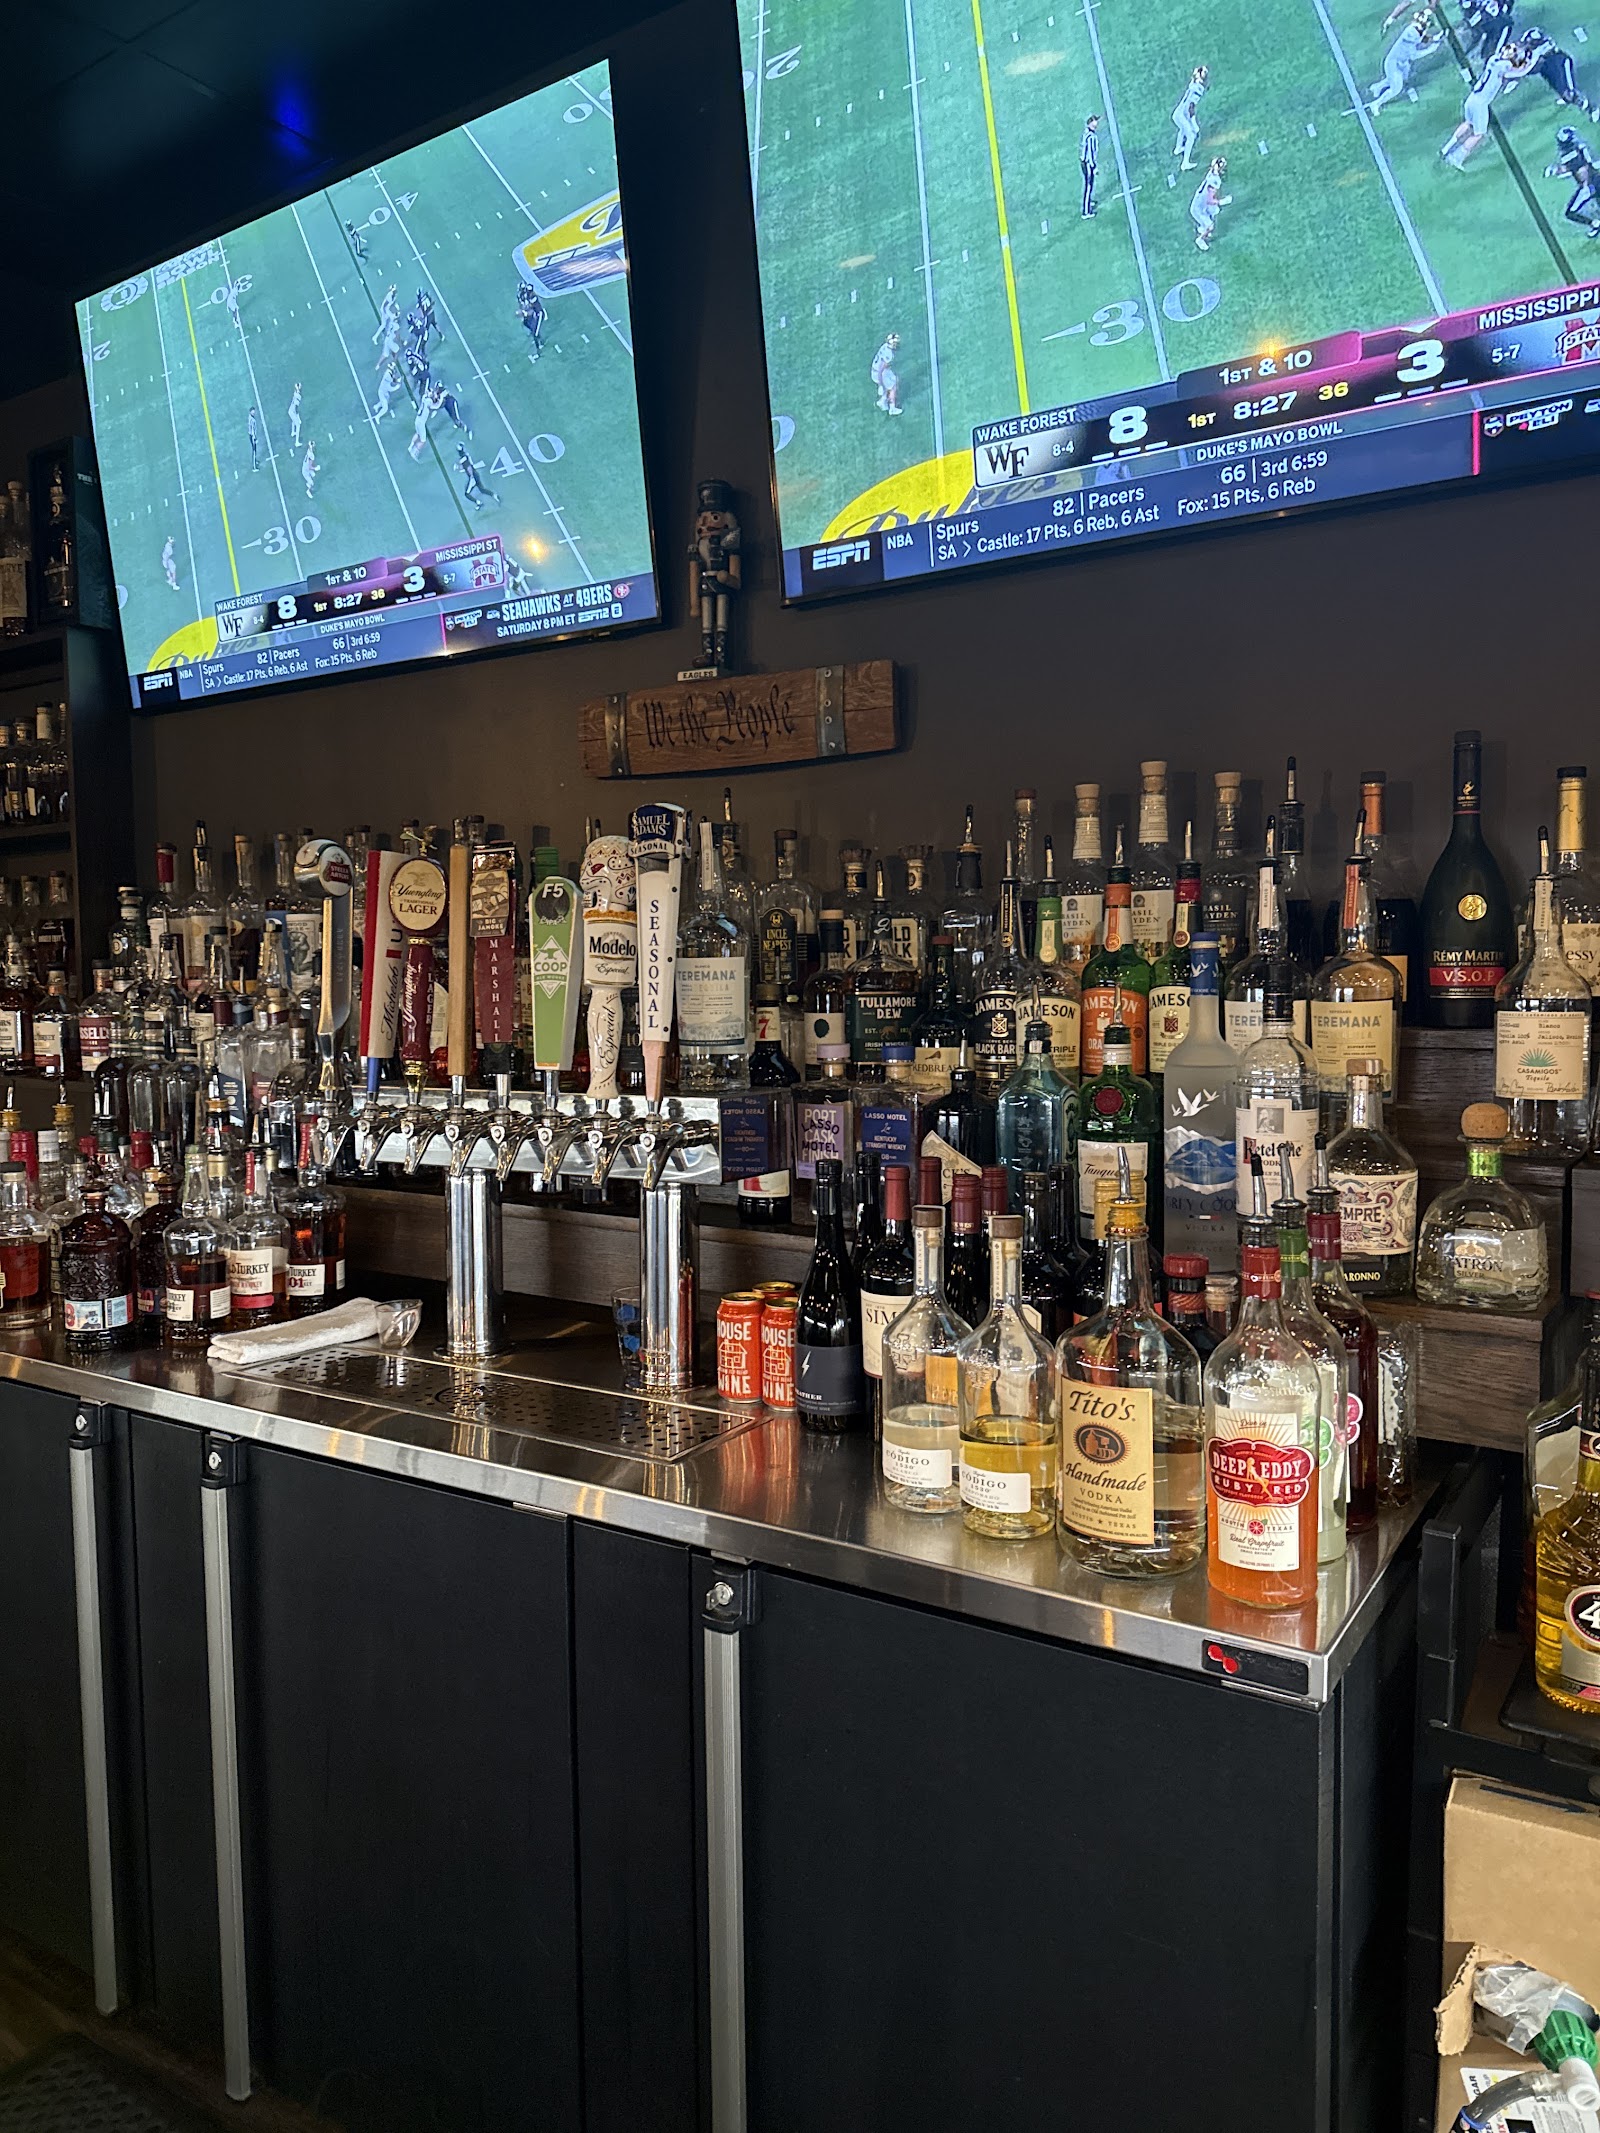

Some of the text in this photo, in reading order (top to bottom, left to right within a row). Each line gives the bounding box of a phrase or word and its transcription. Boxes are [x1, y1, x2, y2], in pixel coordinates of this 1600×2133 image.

[1090, 277, 1221, 347] 30
[1479, 287, 1600, 330] MISSISSIPPI
[1397, 339, 1445, 384] 3
[1491, 343, 1521, 364] 5-7
[1219, 350, 1313, 385] 1ST & 10
[1187, 382, 1349, 429] 1ST 8:27 36
[1508, 401, 1571, 426] PEYTON
[977, 407, 1076, 443] WAKE FOREST
[1108, 405, 1148, 444] 8
[1531, 414, 1557, 429] ELI
[1053, 439, 1074, 457] 8-4
[1196, 421, 1343, 462] DUKE'S MAYO BOWL
[489, 433, 566, 479] 40
[984, 441, 1029, 479] WF
[936, 450, 1328, 540] Spurs 82 Pacers 66 3rd 6:59
[938, 544, 957, 561] SA
[977, 533, 1024, 554] Castle:
[1026, 527, 1042, 545] 17
[1073, 518, 1084, 534] 6
[1087, 513, 1119, 531] Reb,
[1121, 509, 1131, 524] 6
[1134, 504, 1160, 521] Ast
[1177, 497, 1209, 516] Fox:
[1212, 492, 1230, 511] 15
[1267, 481, 1279, 498] 6
[1282, 476, 1316, 497] Reb
[263, 515, 322, 556] 30
[886, 532, 914, 550] NBA
[435, 538, 498, 563] MISSISSIPPI ST
[812, 540, 870, 571] ESPN
[325, 567, 367, 587] 1ST & 10
[403, 566, 425, 592] 3
[443, 572, 456, 584] 5-7
[473, 562, 497, 579] STATE
[216, 594, 263, 612] WAKE FOREST
[277, 594, 297, 620] 8
[314, 589, 385, 613] 1ST 8:27 36
[502, 584, 612, 622] SEAHAWKS AT 49ERS
[320, 614, 385, 634] DUKE'S MAYO BOWL
[497, 619, 543, 638] SATURDAY
[543, 618, 550, 630] 8
[551, 616, 564, 629] PM
[564, 613, 576, 626] ET
[203, 632, 381, 677] Spurs 82 Pacers 66 3rd 6:59
[179, 669, 193, 680] NBA
[205, 648, 377, 689] SA Castle: Ast Fox: Reb
[683, 669, 714, 679] EAGLES
[143, 672, 173, 691] ESPN
[716, 683, 796, 753] People
[632, 813, 670, 827] SAMUEL
[634, 824, 667, 837] ADAMS
[630, 842, 668, 855] SEASONAL
[392, 882, 445, 899] Yuengling
[542, 883, 564, 899] F5
[399, 904, 438, 916] LAGER
[766, 928, 788, 940] UNCLE
[894, 925, 911, 941] LD
[589, 936, 636, 957] Modelo
[763, 939, 793, 950] NEAREST
[647, 899, 660, 1028] SEASONAL
[1433, 949, 1463, 962] RÉMY
[1566, 949, 1598, 964] essy
[534, 961, 567, 973] COOP
[595, 963, 630, 976] Especial
[677, 970, 735, 981] TEREMANA
[1443, 970, 1496, 983] V.S.O.P
[402, 961, 418, 1030] Yuengling
[426, 971, 435, 1026] LAGER
[489, 939, 500, 1043] MARSHALL
[381, 965, 399, 1041] Michelob
[858, 996, 917, 1009] TULLAMORE
[1083, 996, 1138, 1014] AMESON
[876, 1008, 902, 1019] D.E.W.
[599, 1005, 619, 1070] Especial
[758, 1018, 770, 1040] 7
[975, 1043, 995, 1054] BLACK
[1517, 1067, 1559, 1075] CASAMIGOS
[1525, 1074, 1550, 1082] Tequila
[804, 1109, 837, 1124] PORT
[865, 1112, 907, 1121] LASSO MOTEL
[801, 1118, 840, 1135] LASSO
[805, 1129, 835, 1144] CASK
[802, 1140, 838, 1153] MOTEL
[1244, 1138, 1275, 1160] Ketel
[1084, 1163, 1116, 1179] Tanqu
[1339, 1206, 1382, 1223] EMPRE
[237, 1263, 269, 1279] TURKEY
[290, 1266, 316, 1277] TURKEY
[1457, 1270, 1486, 1279] SILVER
[866, 1308, 897, 1325] SIM
[717, 1321, 751, 1341] HOUSE
[762, 1326, 796, 1348] HOUSE
[717, 1375, 751, 1395] WINE
[763, 1381, 795, 1402] WINE
[1069, 1388, 1135, 1421] Tito's
[886, 1449, 930, 1467] CÓDIGO
[895, 1462, 914, 1470] 1530
[1213, 1451, 1302, 1479] DEEP EDDY
[961, 1470, 1007, 1490] CÓDIGO
[1065, 1462, 1147, 1491] Handmade
[1214, 1475, 1302, 1495] RUBY RED
[970, 1483, 990, 1493] 1530
[1080, 1487, 1123, 1504] VODKA
[1108, 1521, 1136, 1529] TEXAS
[1221, 1517, 1245, 1529] AUSTIN
[1229, 1533, 1285, 1549] Real Grapefruit
